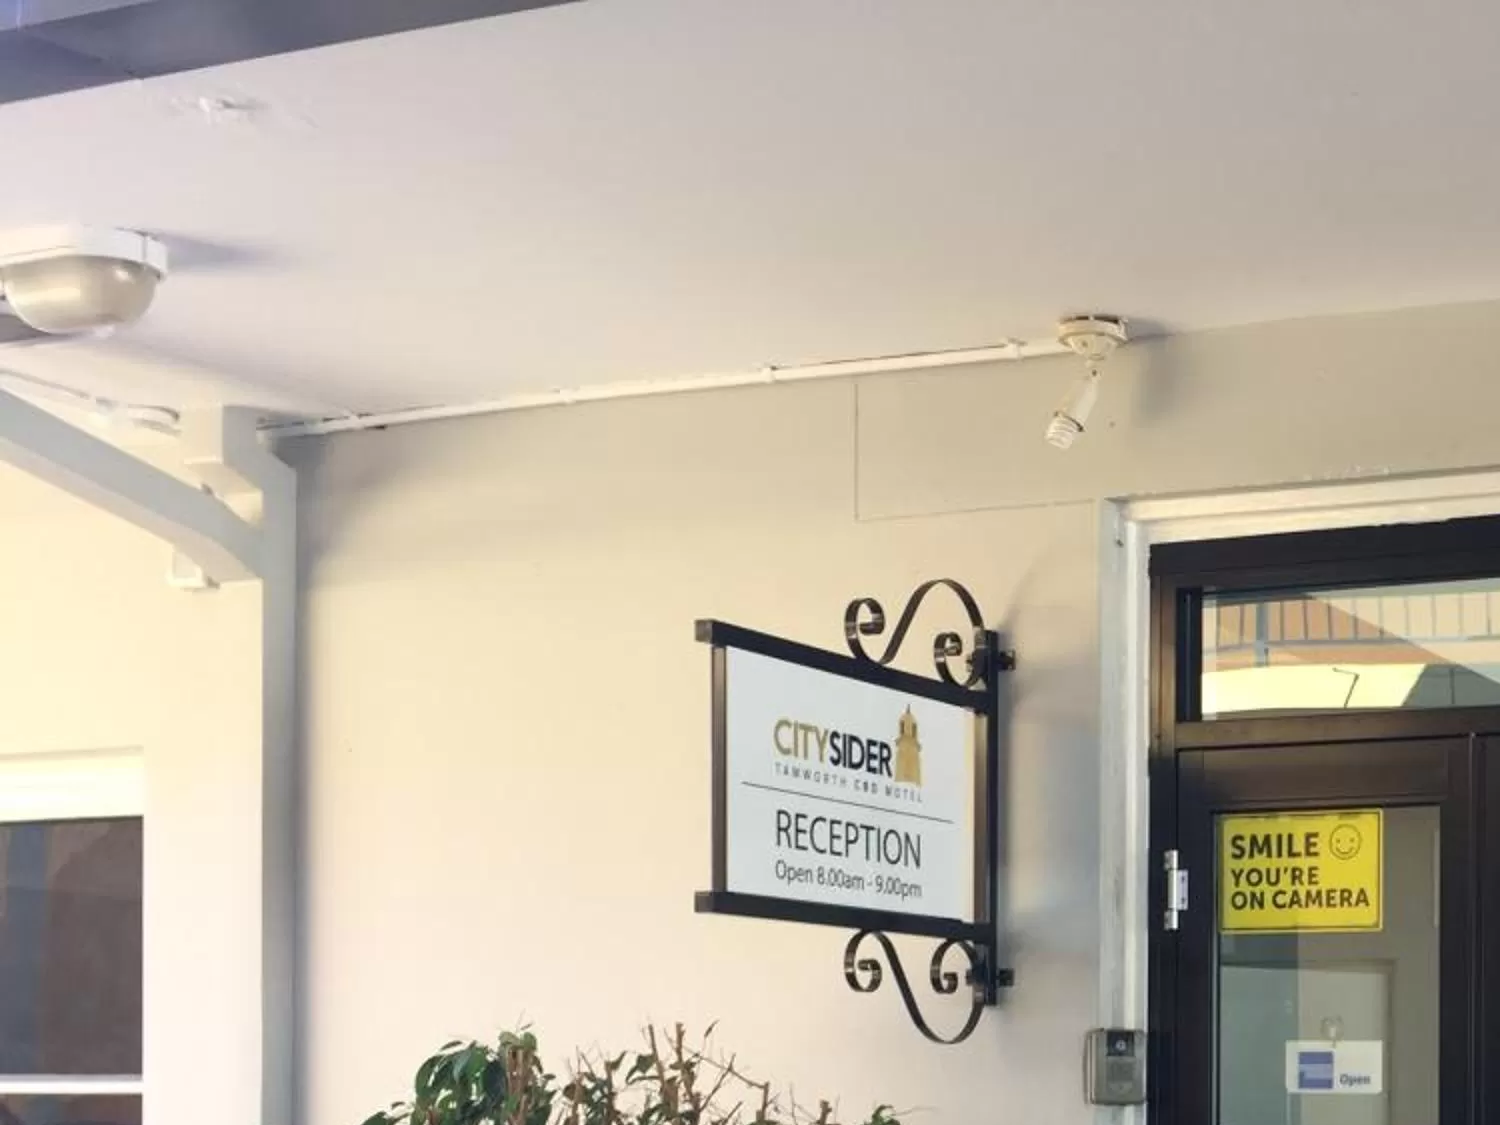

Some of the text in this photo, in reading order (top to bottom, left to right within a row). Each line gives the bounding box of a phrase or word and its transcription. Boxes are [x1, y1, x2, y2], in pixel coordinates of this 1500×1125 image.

[774, 719, 893, 778] CITYSIDER
[775, 762, 923, 803] TAMWORTH CBD MOTEL
[776, 809, 921, 869] RECEPTION
[1231, 831, 1320, 861] SMILE
[775, 859, 813, 886] Open
[816, 866, 865, 891] 8.00am
[875, 876, 923, 901] 9.00pm
[1231, 866, 1320, 889] YOU'RE
[1231, 887, 1371, 910] ON CAMERA
[1340, 1073, 1371, 1087] Open
